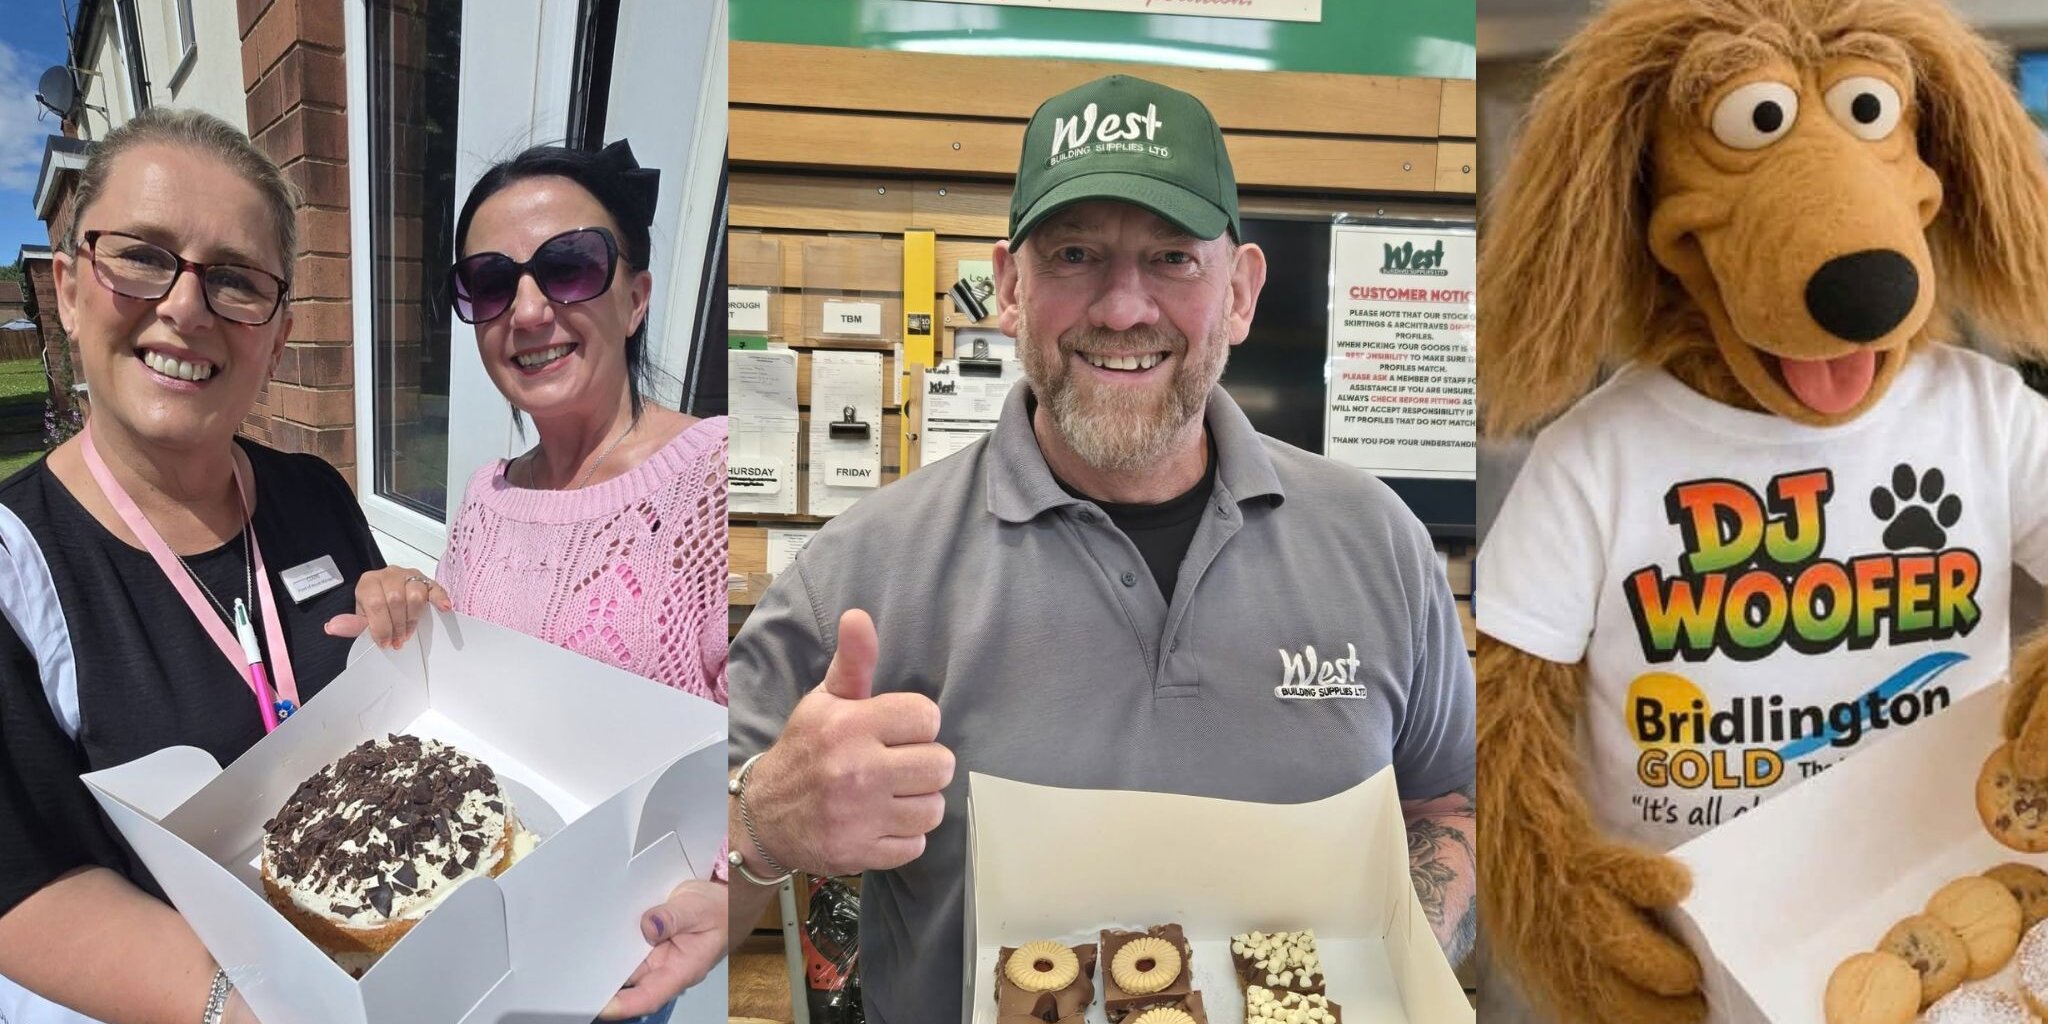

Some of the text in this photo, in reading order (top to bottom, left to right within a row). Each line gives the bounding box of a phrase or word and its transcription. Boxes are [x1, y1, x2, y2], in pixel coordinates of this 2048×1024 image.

[1051, 103, 1162, 157] West
[1050, 142, 1168, 166] BUILDING SUPPLIES LTD
[1383, 240, 1444, 270] West
[1349, 286, 1428, 301] CUSTOMER
[841, 314, 862, 323] TBM
[1349, 309, 1378, 317] PLEASE
[1380, 310, 1400, 318] NOTE
[1442, 312, 1468, 320] STOCK
[1344, 320, 1386, 328] SKIRTINGS
[1394, 321, 1448, 330] ARCHITRAVES
[1395, 332, 1434, 340] PROFILES.
[1336, 341, 1361, 349] WHEN
[1362, 341, 1395, 350] PICKING
[1397, 342, 1419, 350] YOUR
[1421, 344, 1450, 352] GOODS
[1452, 344, 1459, 352] IT
[1380, 364, 1447, 373] PROFILES MATCH.
[1396, 375, 1429, 383] MEMBER
[1443, 376, 1466, 384] STAFF
[1349, 384, 1397, 392] ASSISTANCE
[1426, 386, 1440, 394] ARE
[1442, 387, 1475, 395] UNSURE.
[1337, 394, 1369, 402] ALWAYS
[1371, 395, 1397, 403] CHECK
[1399, 396, 1429, 404] BEFORE
[1462, 398, 1472, 406] AS
[1352, 405, 1369, 413] NOT
[1370, 406, 1400, 414] ACCEPT
[1402, 407, 1464, 416] RESPONSIBILITY
[1357, 416, 1394, 424] PROFILES
[1332, 436, 1359, 444] THANK
[1360, 437, 1377, 445] YOU
[836, 468, 872, 477] FRIDAY
[1665, 468, 1834, 574] DJ
[1623, 547, 1982, 664] WOOFER
[1279, 642, 1360, 686] West
[1281, 687, 1317, 697] BUILDING
[1319, 687, 1354, 697] SUPPLIES
[1635, 686, 1950, 747] Bridlington
[1637, 748, 1785, 789] GOLD
[1688, 796, 1723, 826] all
